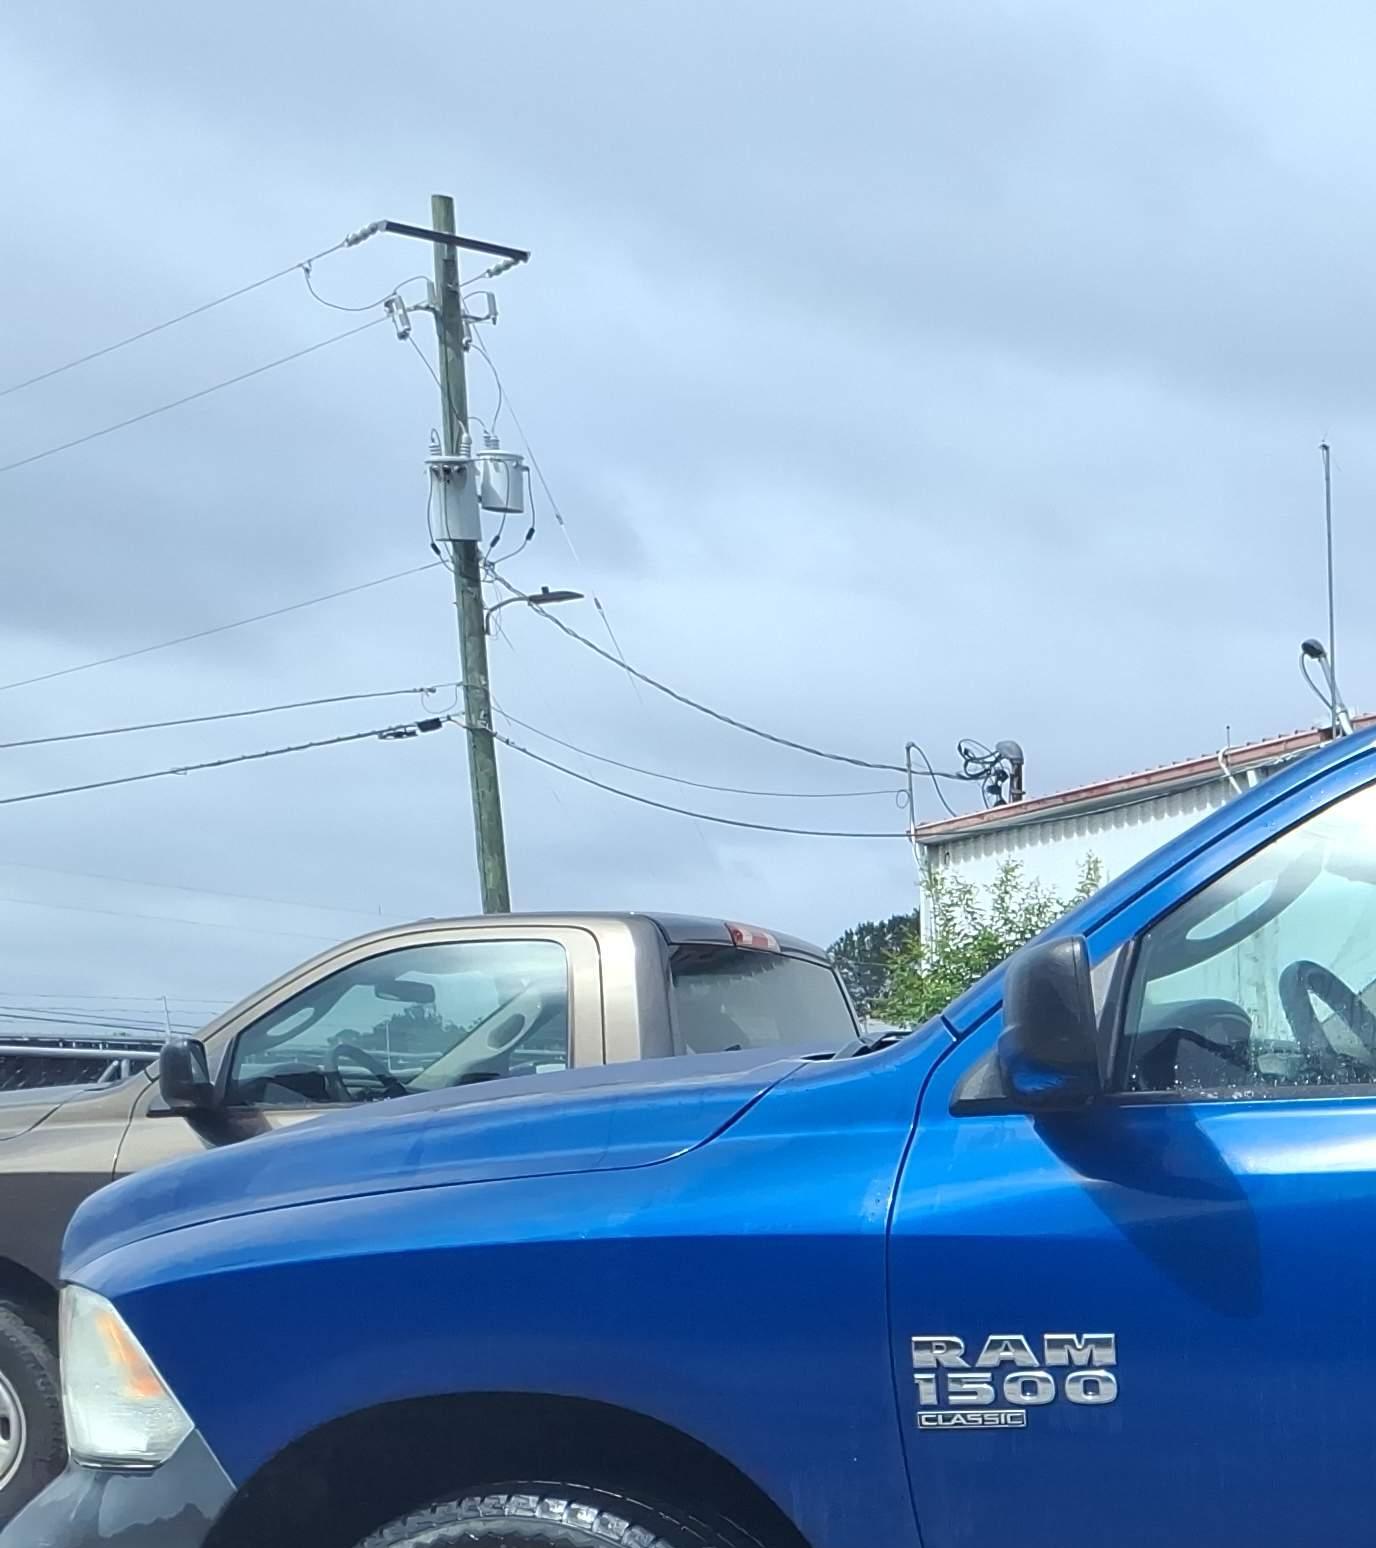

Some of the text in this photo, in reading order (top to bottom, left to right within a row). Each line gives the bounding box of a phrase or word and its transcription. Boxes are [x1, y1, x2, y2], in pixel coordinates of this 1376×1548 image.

[911, 1333, 1117, 1369] RAM
[913, 1369, 1118, 1406] 1500
[920, 1411, 1025, 1427] CLASSIC
